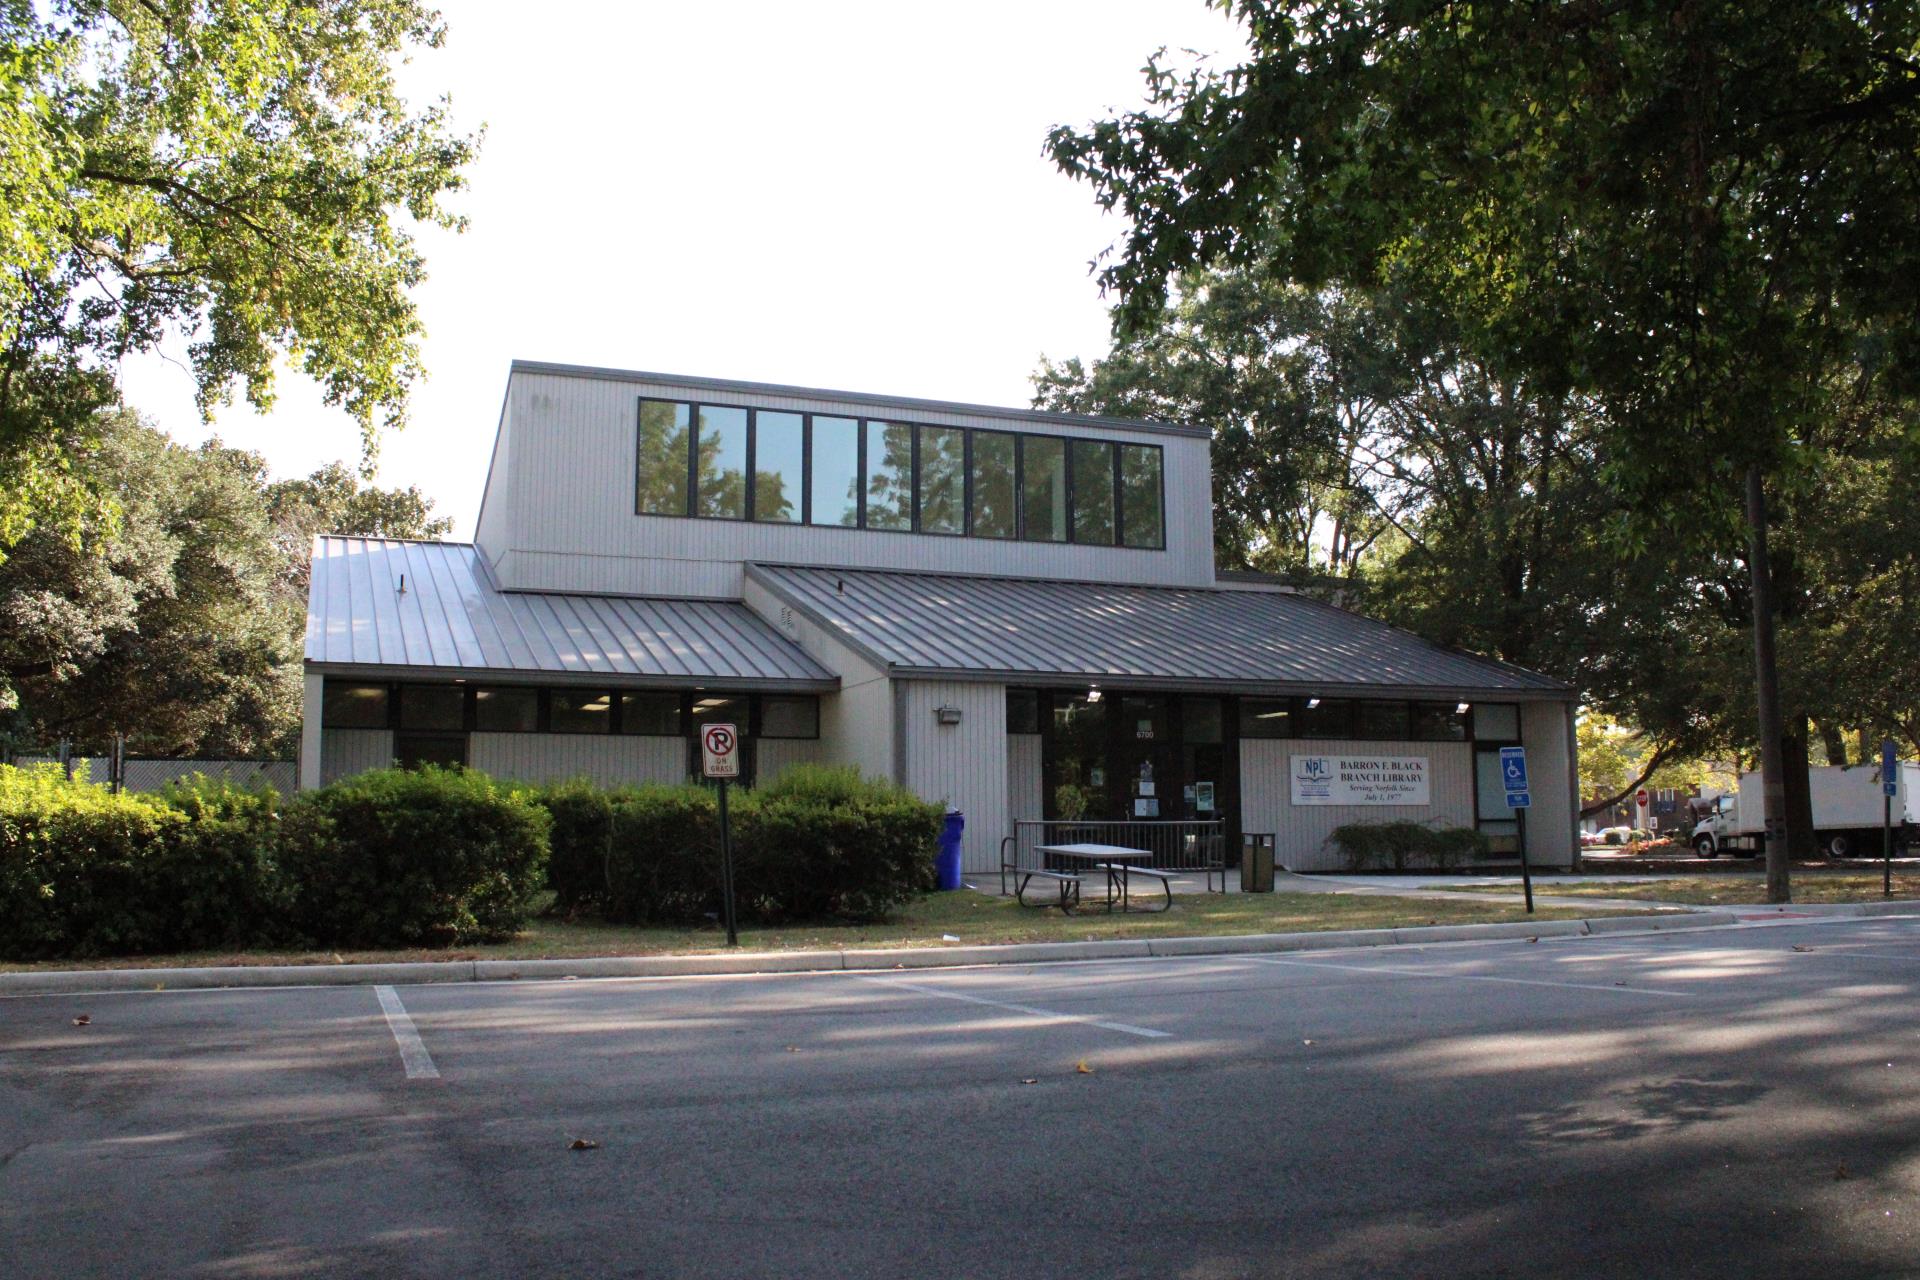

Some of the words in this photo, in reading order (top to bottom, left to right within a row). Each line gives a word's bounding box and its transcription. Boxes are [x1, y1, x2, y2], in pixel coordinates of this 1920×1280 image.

[1136, 731, 1154, 739] 6700
[710, 765, 733, 773] GRASS
[1305, 758, 1325, 777] NPL
[1340, 760, 1380, 770] BARRON
[1382, 761, 1389, 770] F.
[1391, 761, 1423, 771] BLACK
[1341, 773, 1380, 782] BRANCH
[1382, 773, 1423, 783] LIBRARY
[1350, 784, 1373, 793] Serving
[1375, 784, 1398, 793] Norfolk
[1400, 784, 1416, 792] Since
[1387, 793, 1402, 801] 1977
